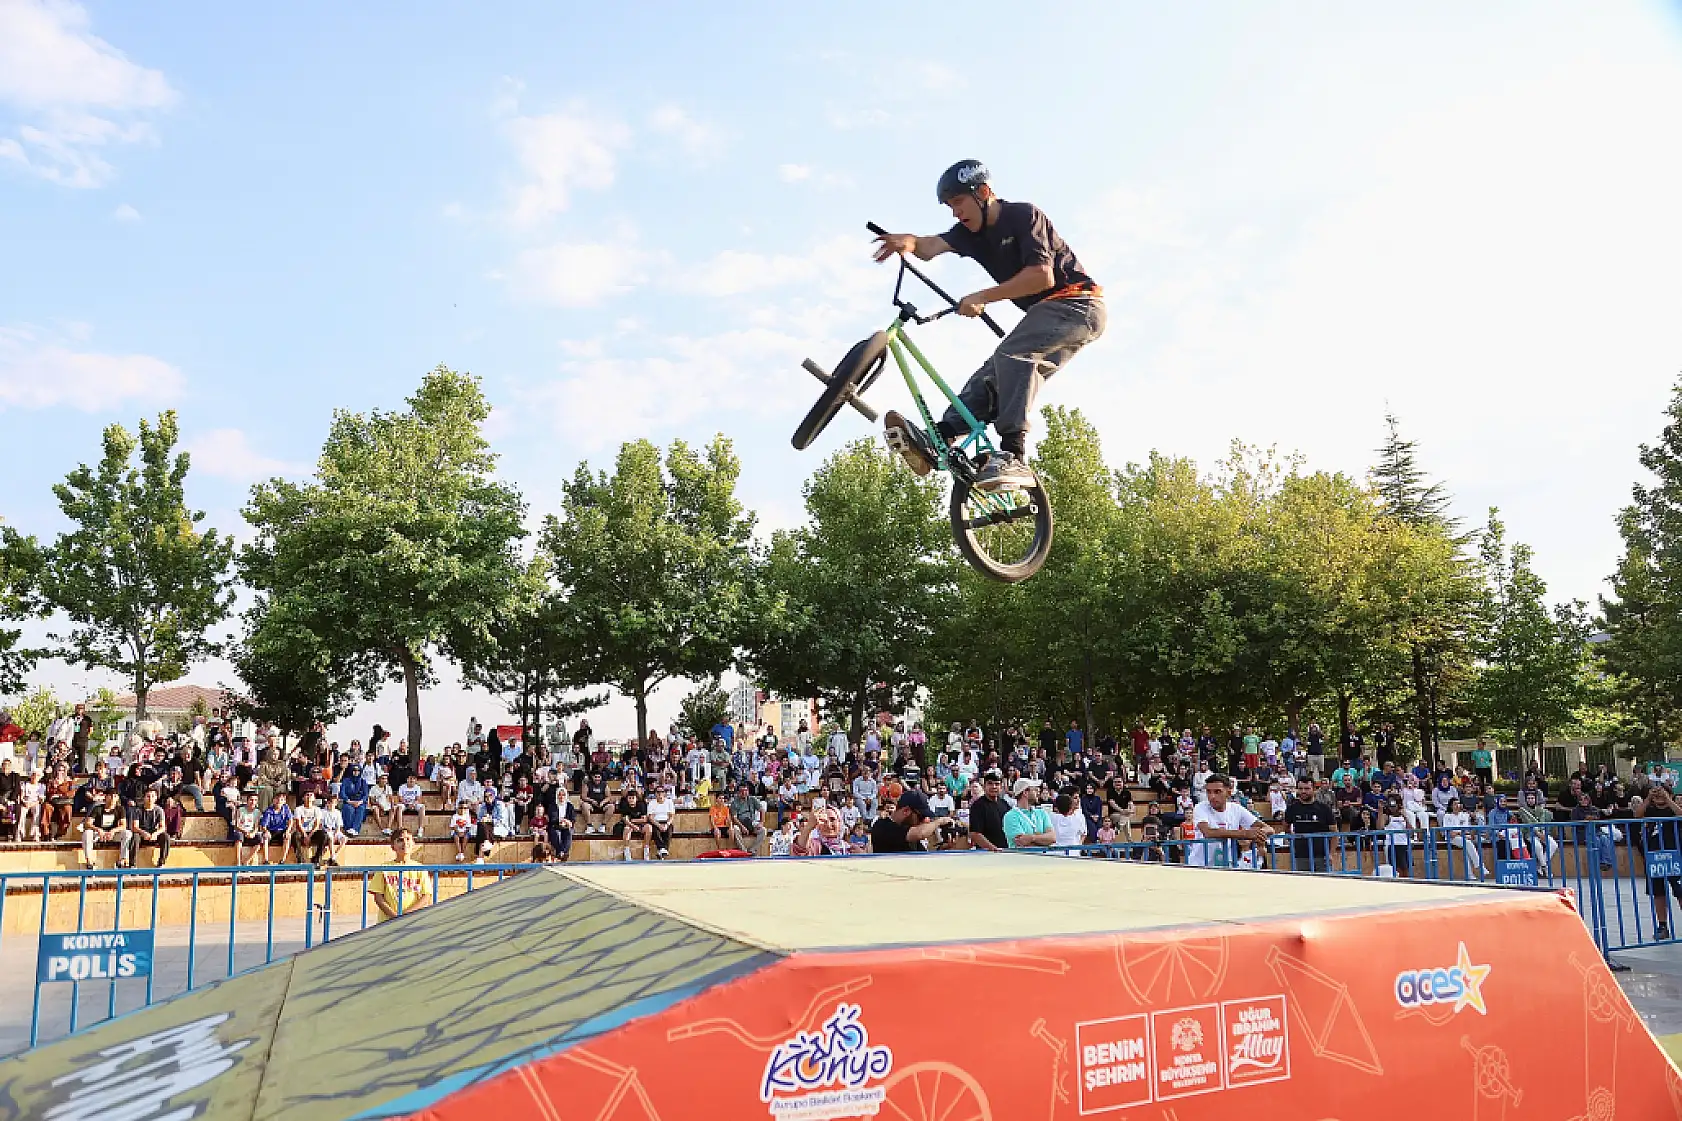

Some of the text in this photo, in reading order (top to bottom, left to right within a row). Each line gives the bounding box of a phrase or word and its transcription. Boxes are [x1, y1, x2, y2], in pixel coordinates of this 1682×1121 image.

[63, 933, 125, 950] KONYA
[48, 949, 136, 980] POLİS
[1398, 968, 1464, 1004] aces
[763, 1036, 889, 1098] Konya
